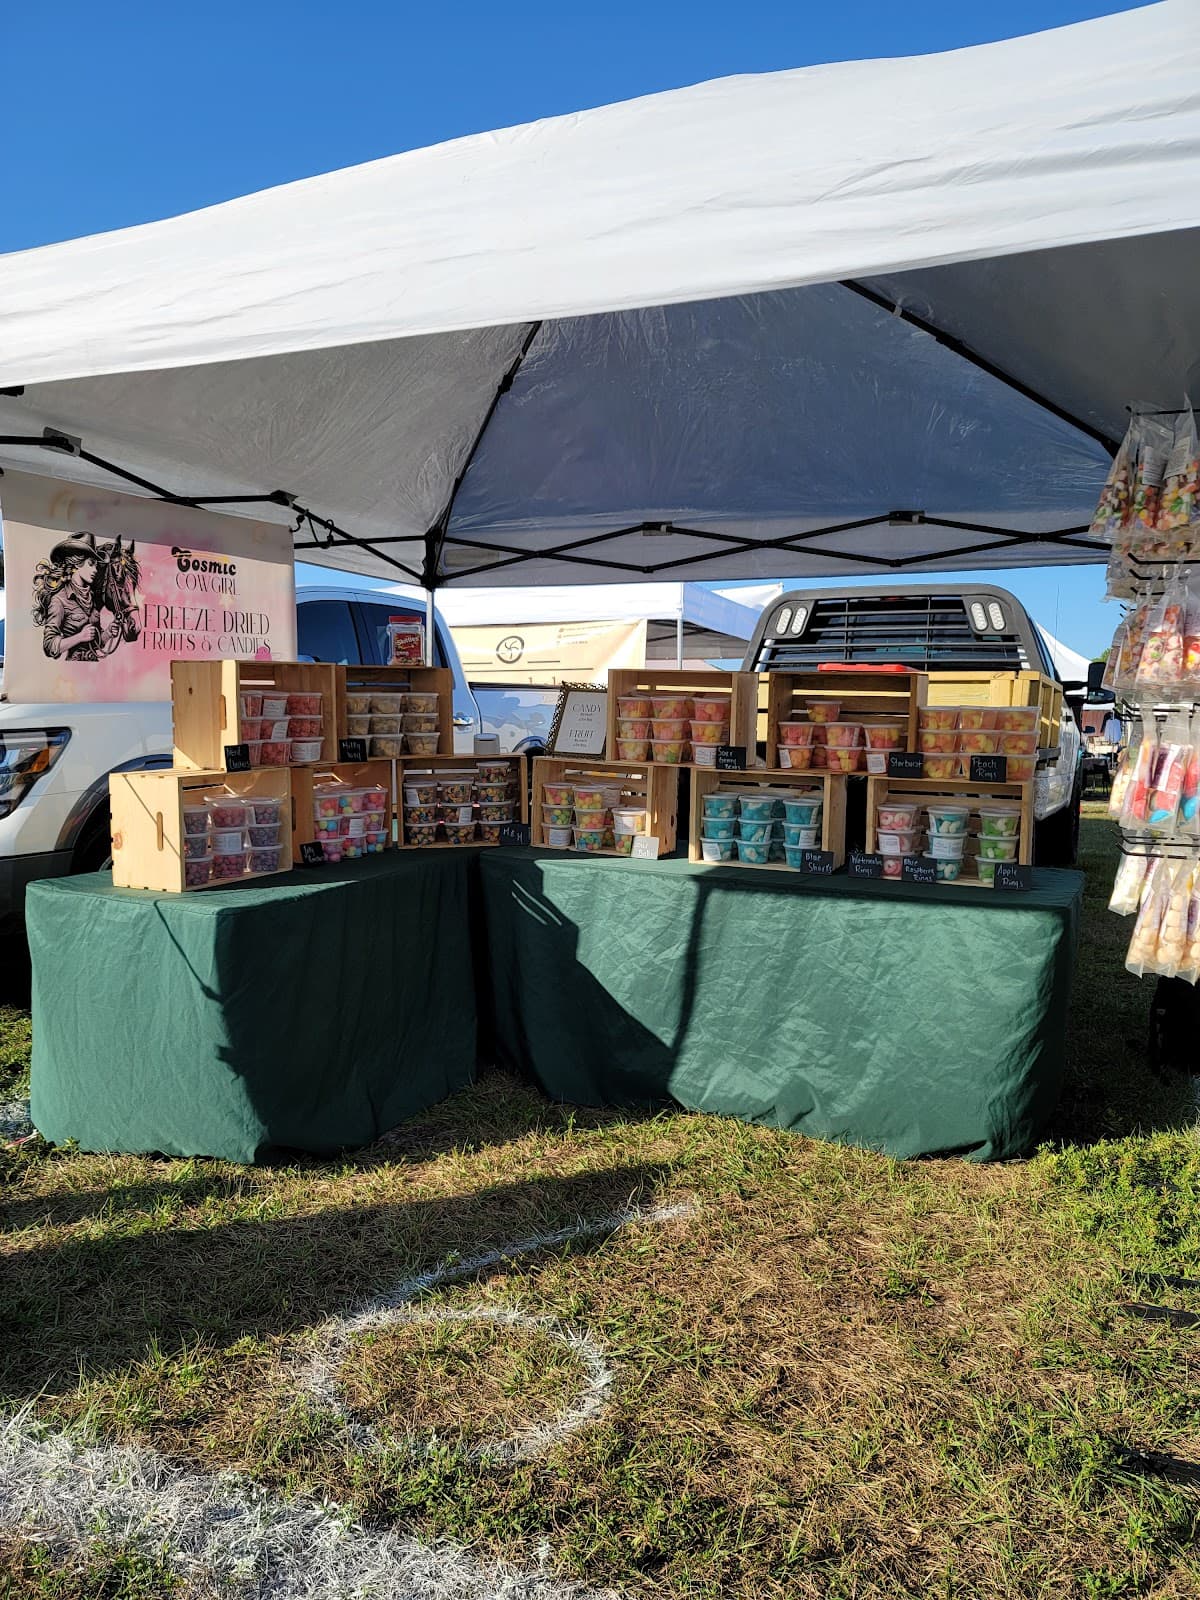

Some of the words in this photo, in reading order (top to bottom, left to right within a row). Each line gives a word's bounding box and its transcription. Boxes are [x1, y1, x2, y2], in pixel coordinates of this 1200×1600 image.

[175, 573, 240, 596] COWGIRL
[144, 604, 216, 632] FREEZE
[223, 610, 270, 636] DRIED
[143, 631, 196, 652] FRUITS
[201, 635, 213, 652] &
[217, 636, 271, 654] CANDIES
[572, 703, 602, 713] CANDY
